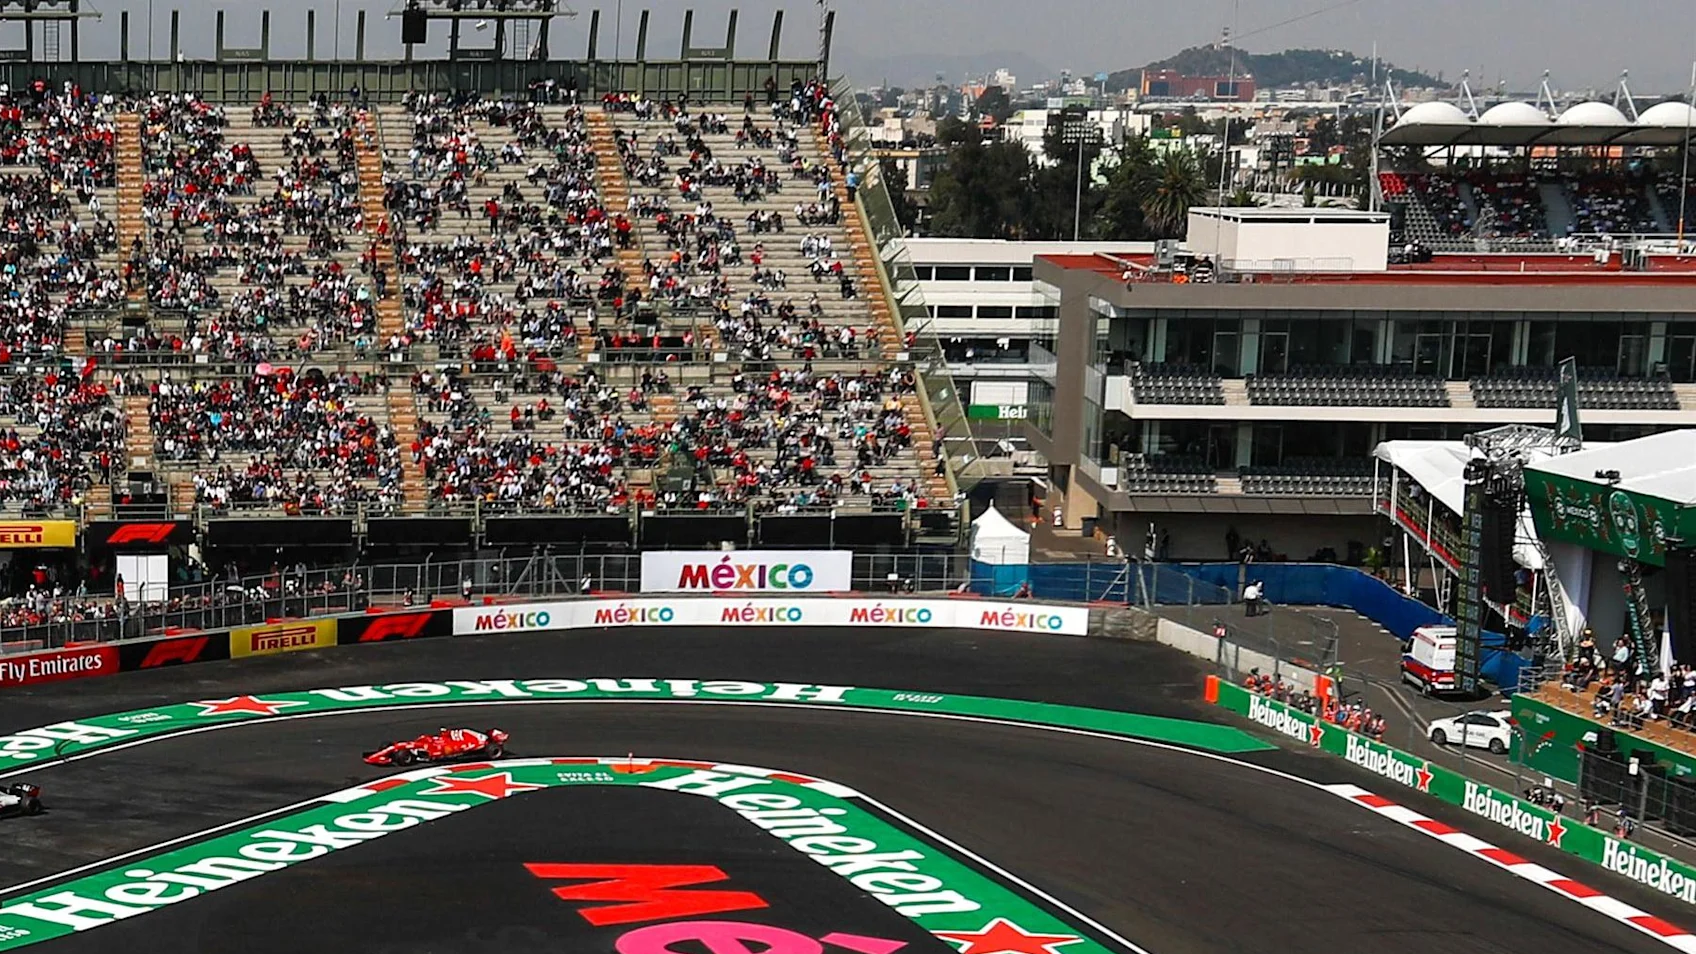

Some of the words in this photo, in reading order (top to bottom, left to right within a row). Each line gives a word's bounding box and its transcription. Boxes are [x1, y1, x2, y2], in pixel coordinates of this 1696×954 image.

[250, 625, 316, 651] PIRELLI
[29, 653, 103, 677] Emirates
[308, 677, 856, 703] Heineken
[1248, 694, 1307, 742] Heineken
[1345, 733, 1415, 785] Heineken
[1463, 781, 1544, 840] Heineken
[639, 768, 981, 918] Heineken
[1603, 835, 1696, 905] Heineken
